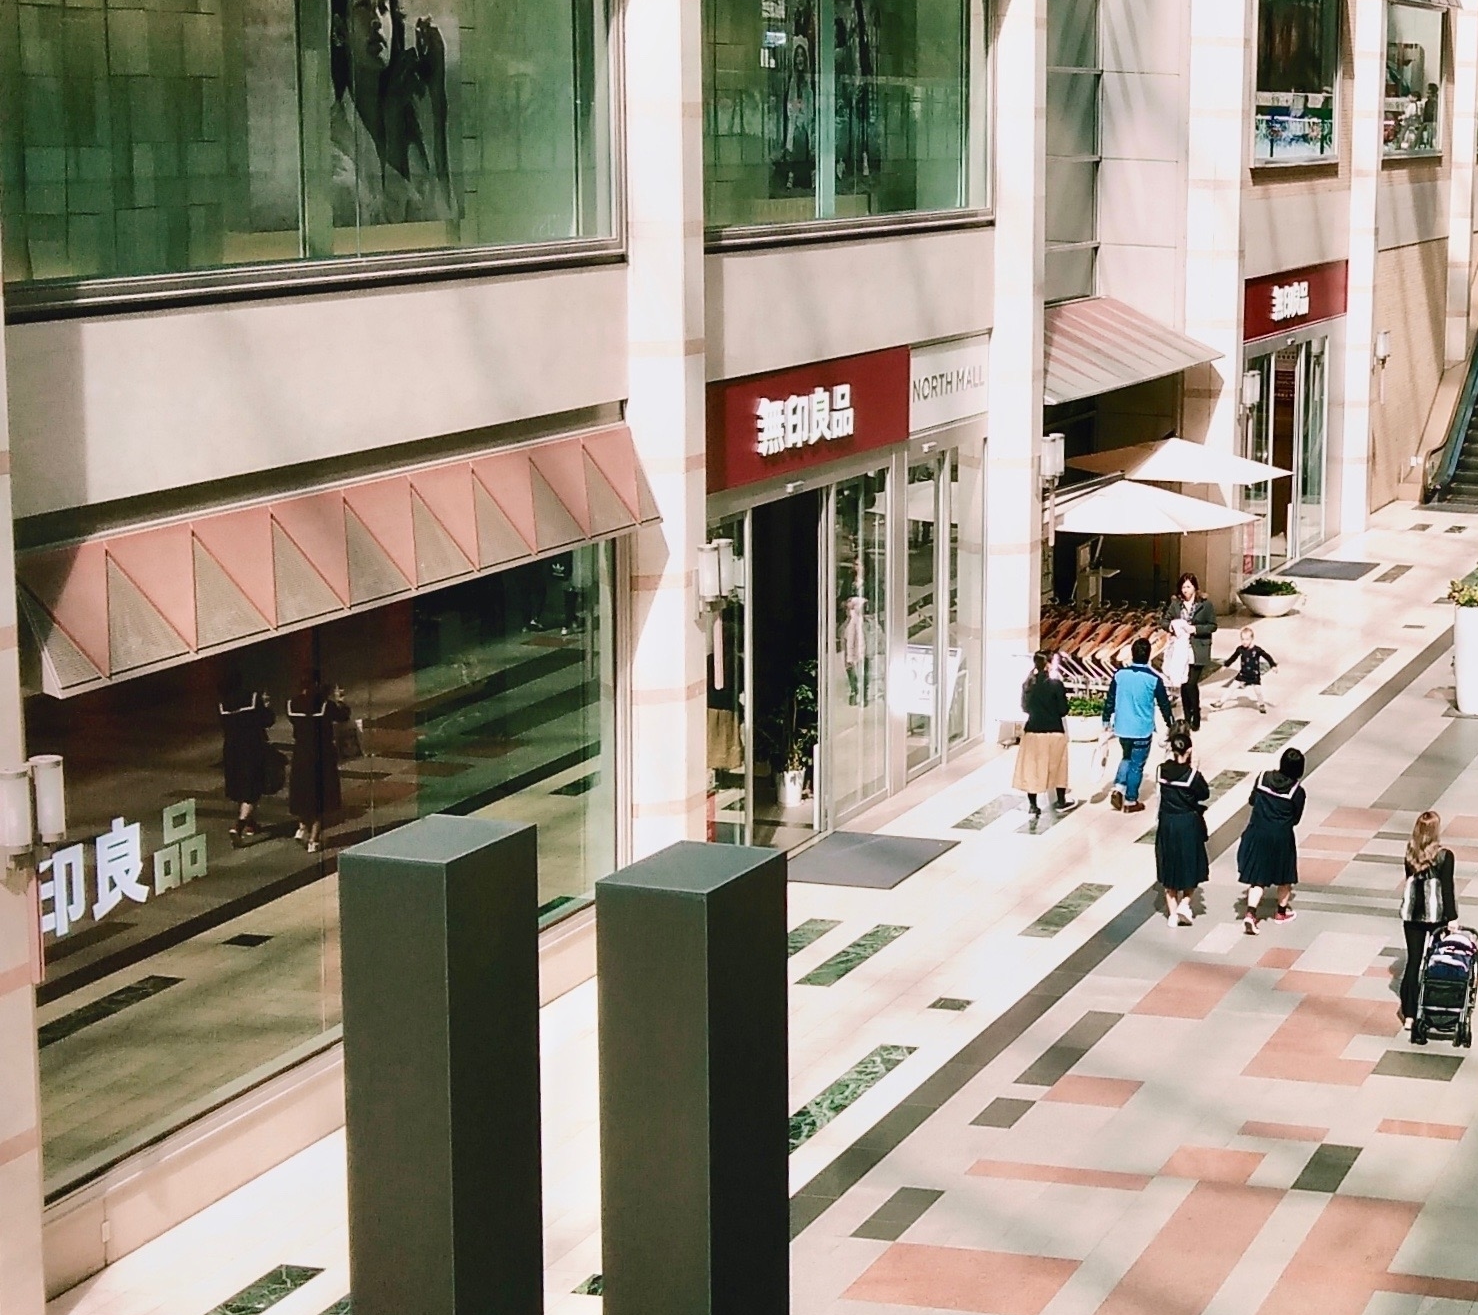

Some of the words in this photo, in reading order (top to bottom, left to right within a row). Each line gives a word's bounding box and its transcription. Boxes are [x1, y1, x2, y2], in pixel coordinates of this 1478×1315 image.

[912, 373, 953, 404] NORTH
[956, 364, 986, 394] MALL
[756, 383, 855, 457] 無印良品
